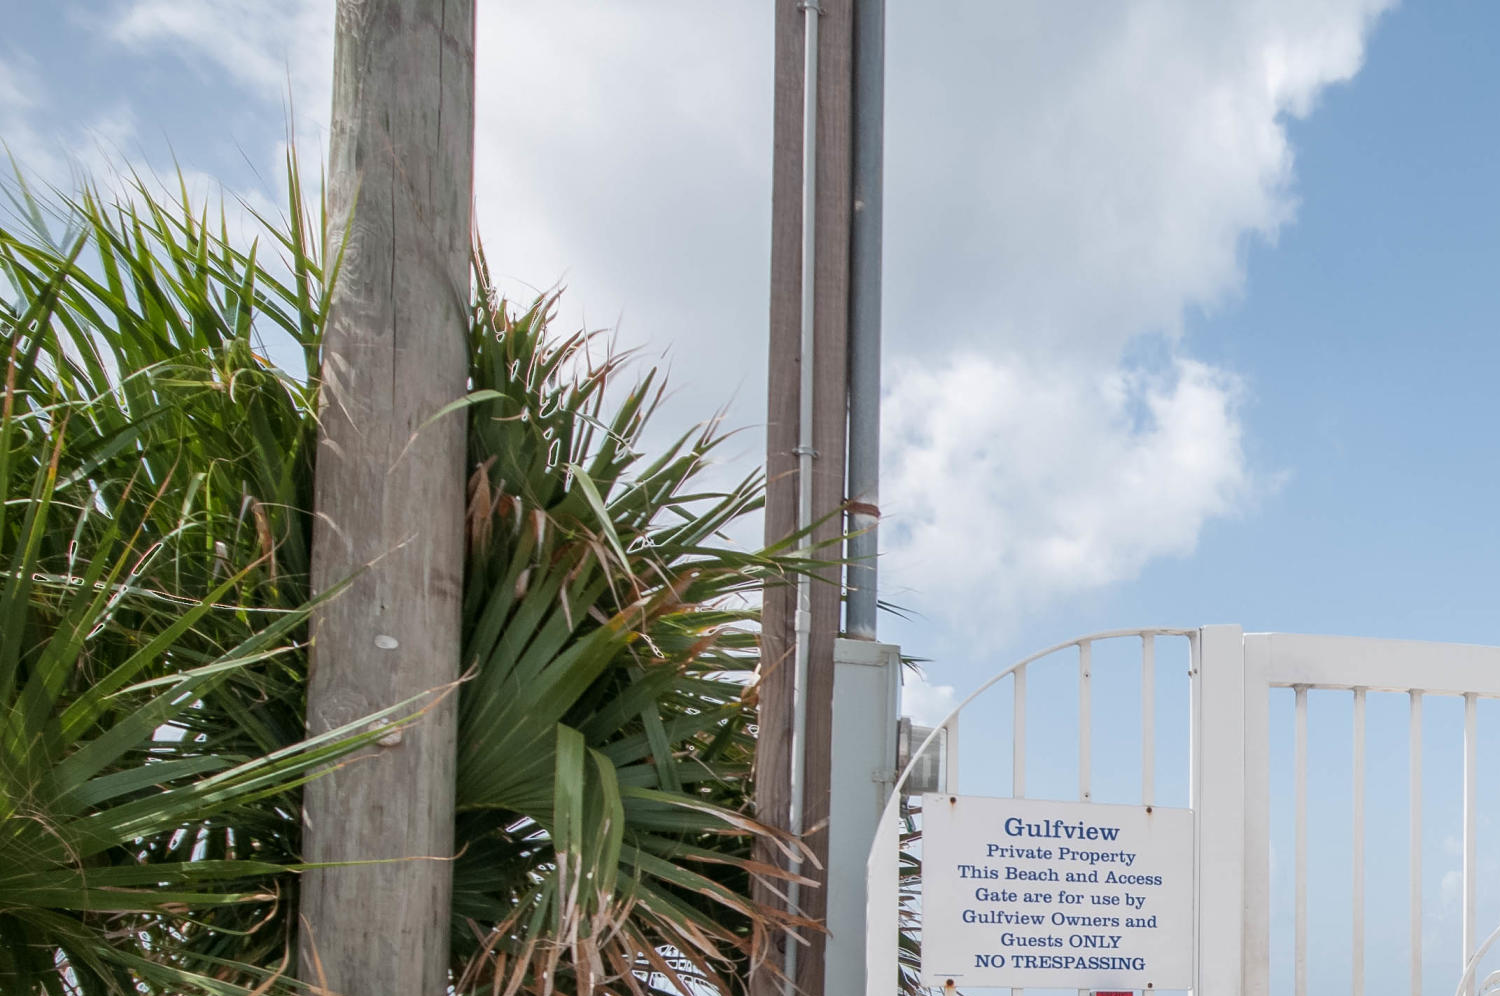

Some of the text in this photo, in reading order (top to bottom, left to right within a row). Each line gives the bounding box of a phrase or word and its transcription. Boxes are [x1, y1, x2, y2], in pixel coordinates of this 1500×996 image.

[1004, 817, 1120, 841] Gulfview
[986, 843, 1136, 866] Private Property
[957, 865, 1163, 886] This Beach and Access
[975, 888, 1146, 909] Gate are for use by
[962, 909, 1157, 928] Gulfview Owners and
[1000, 933, 1122, 949] Guests ONLY
[974, 954, 1146, 971] NO TRESPASSING
